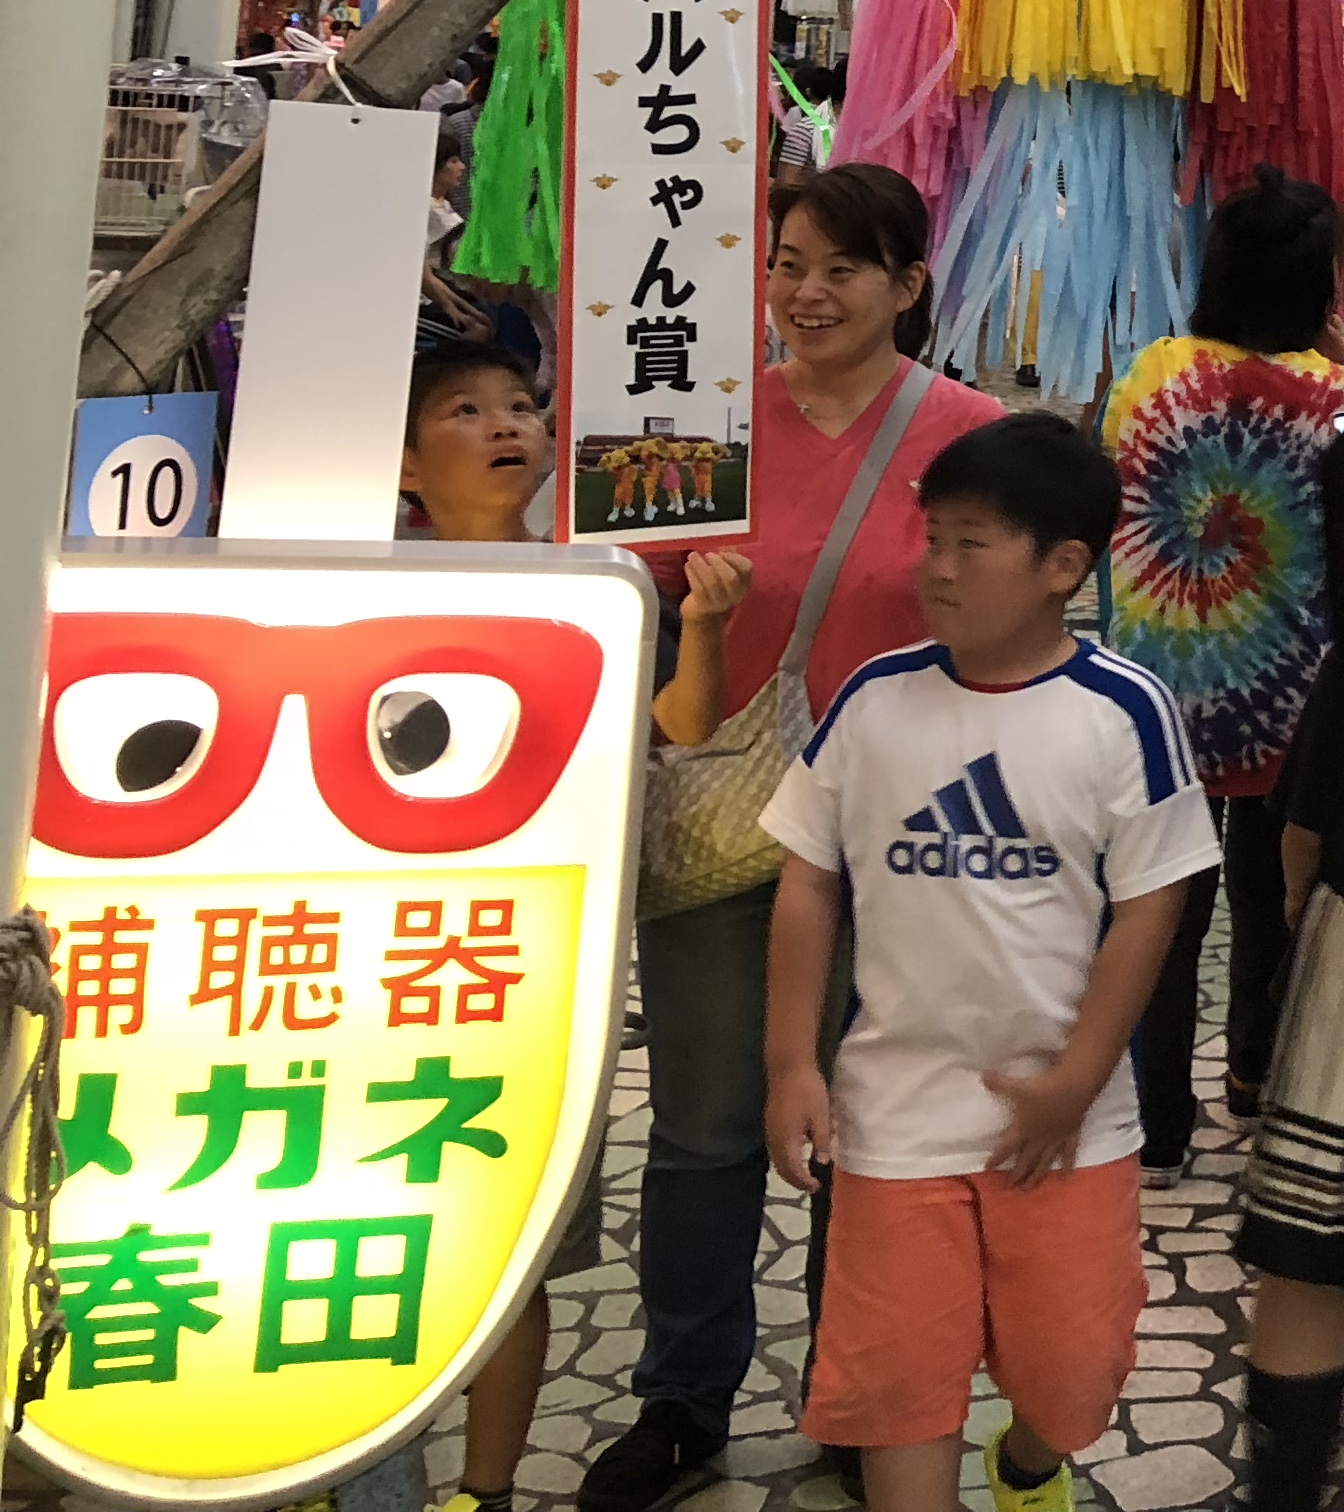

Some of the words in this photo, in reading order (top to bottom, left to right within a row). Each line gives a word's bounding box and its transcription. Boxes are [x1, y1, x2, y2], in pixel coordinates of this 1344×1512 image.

[109, 457, 183, 532] 10
[886, 832, 1061, 879] adidas
[52, 898, 526, 1039] 補聴器
[50, 1058, 508, 1192] メガネ
[54, 1214, 437, 1392] 春田
